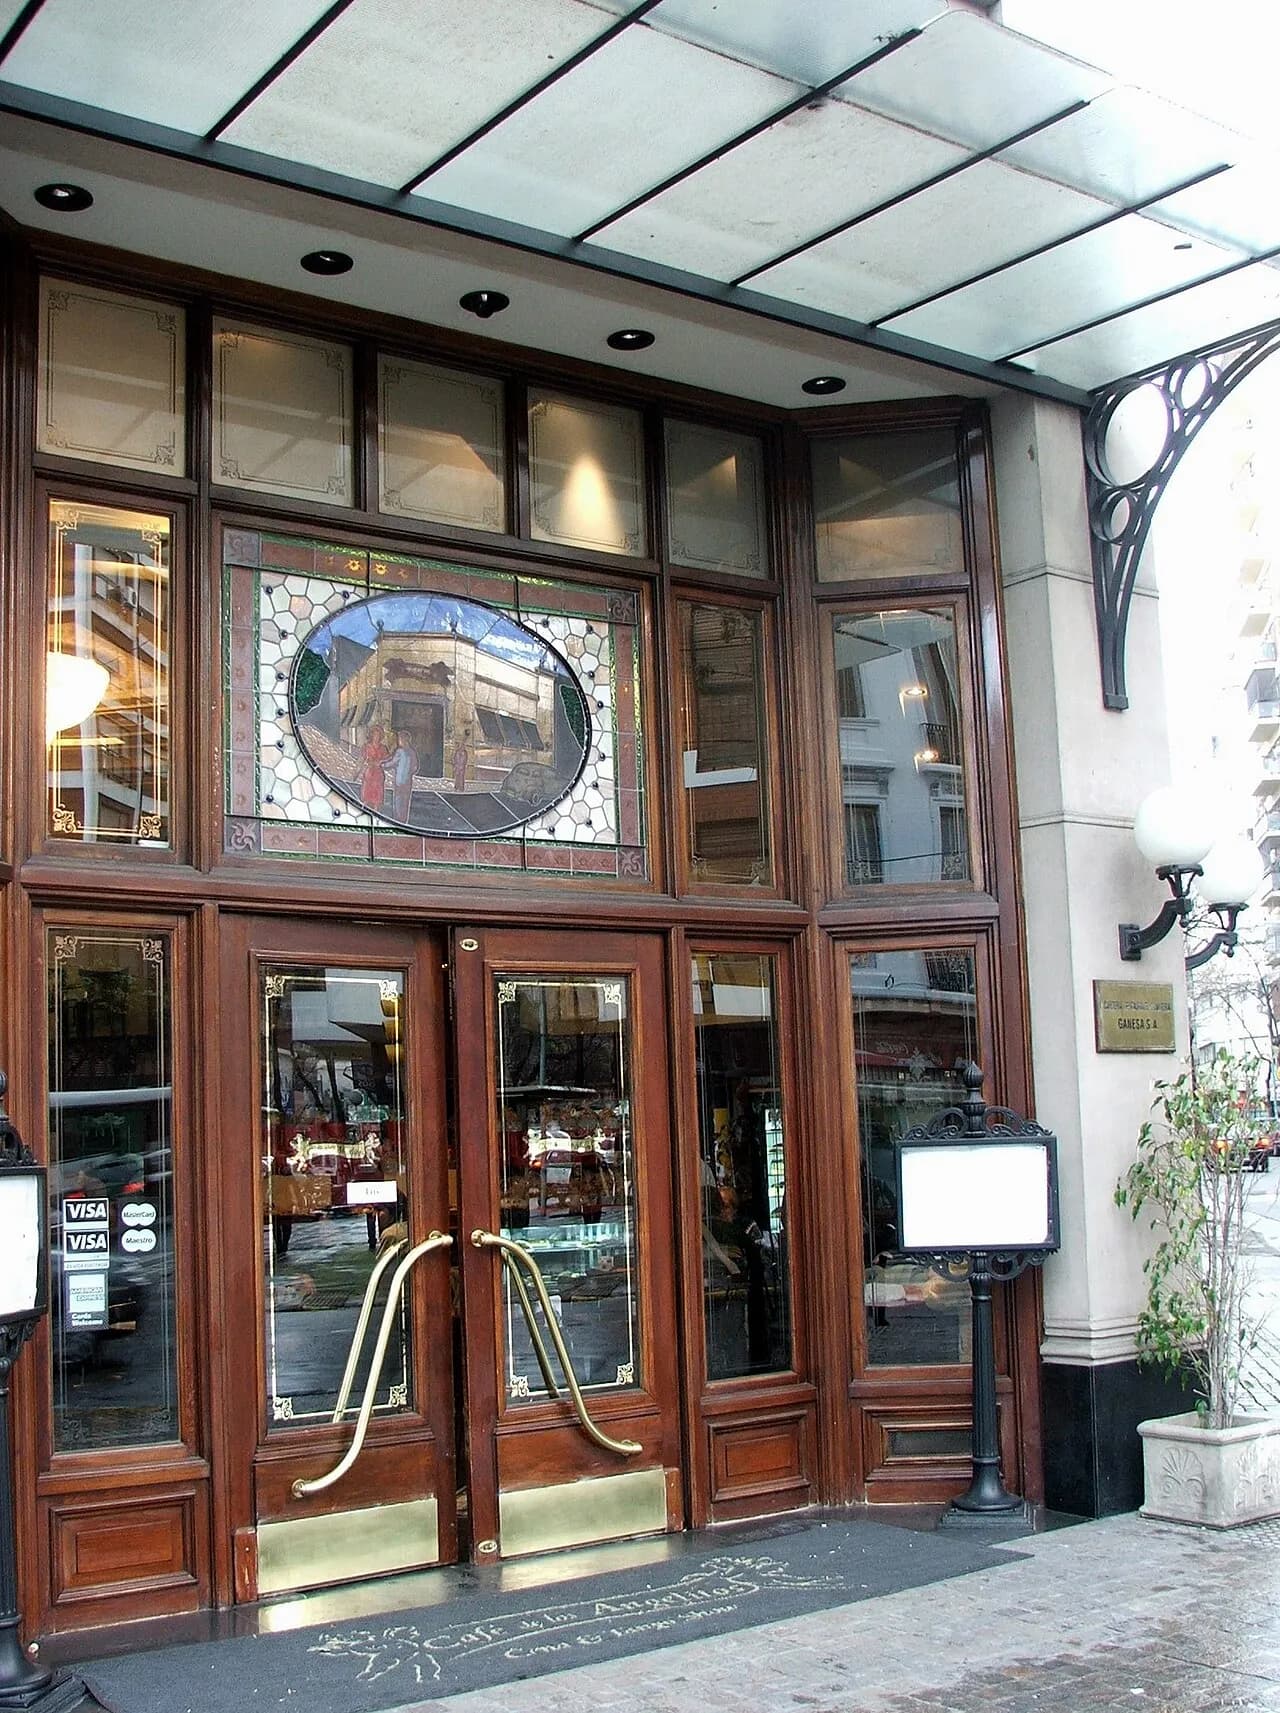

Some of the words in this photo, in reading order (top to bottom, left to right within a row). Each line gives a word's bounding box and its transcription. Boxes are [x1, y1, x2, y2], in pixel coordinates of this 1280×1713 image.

[1117, 1017, 1145, 1030] GANESA
[66, 1202, 107, 1219] VISA
[123, 1211, 155, 1219] MasterCard
[67, 1233, 107, 1250] VISA
[125, 1236, 153, 1244] Maestro
[543, 1612, 578, 1624] los
[595, 1583, 745, 1616] Angelitos
